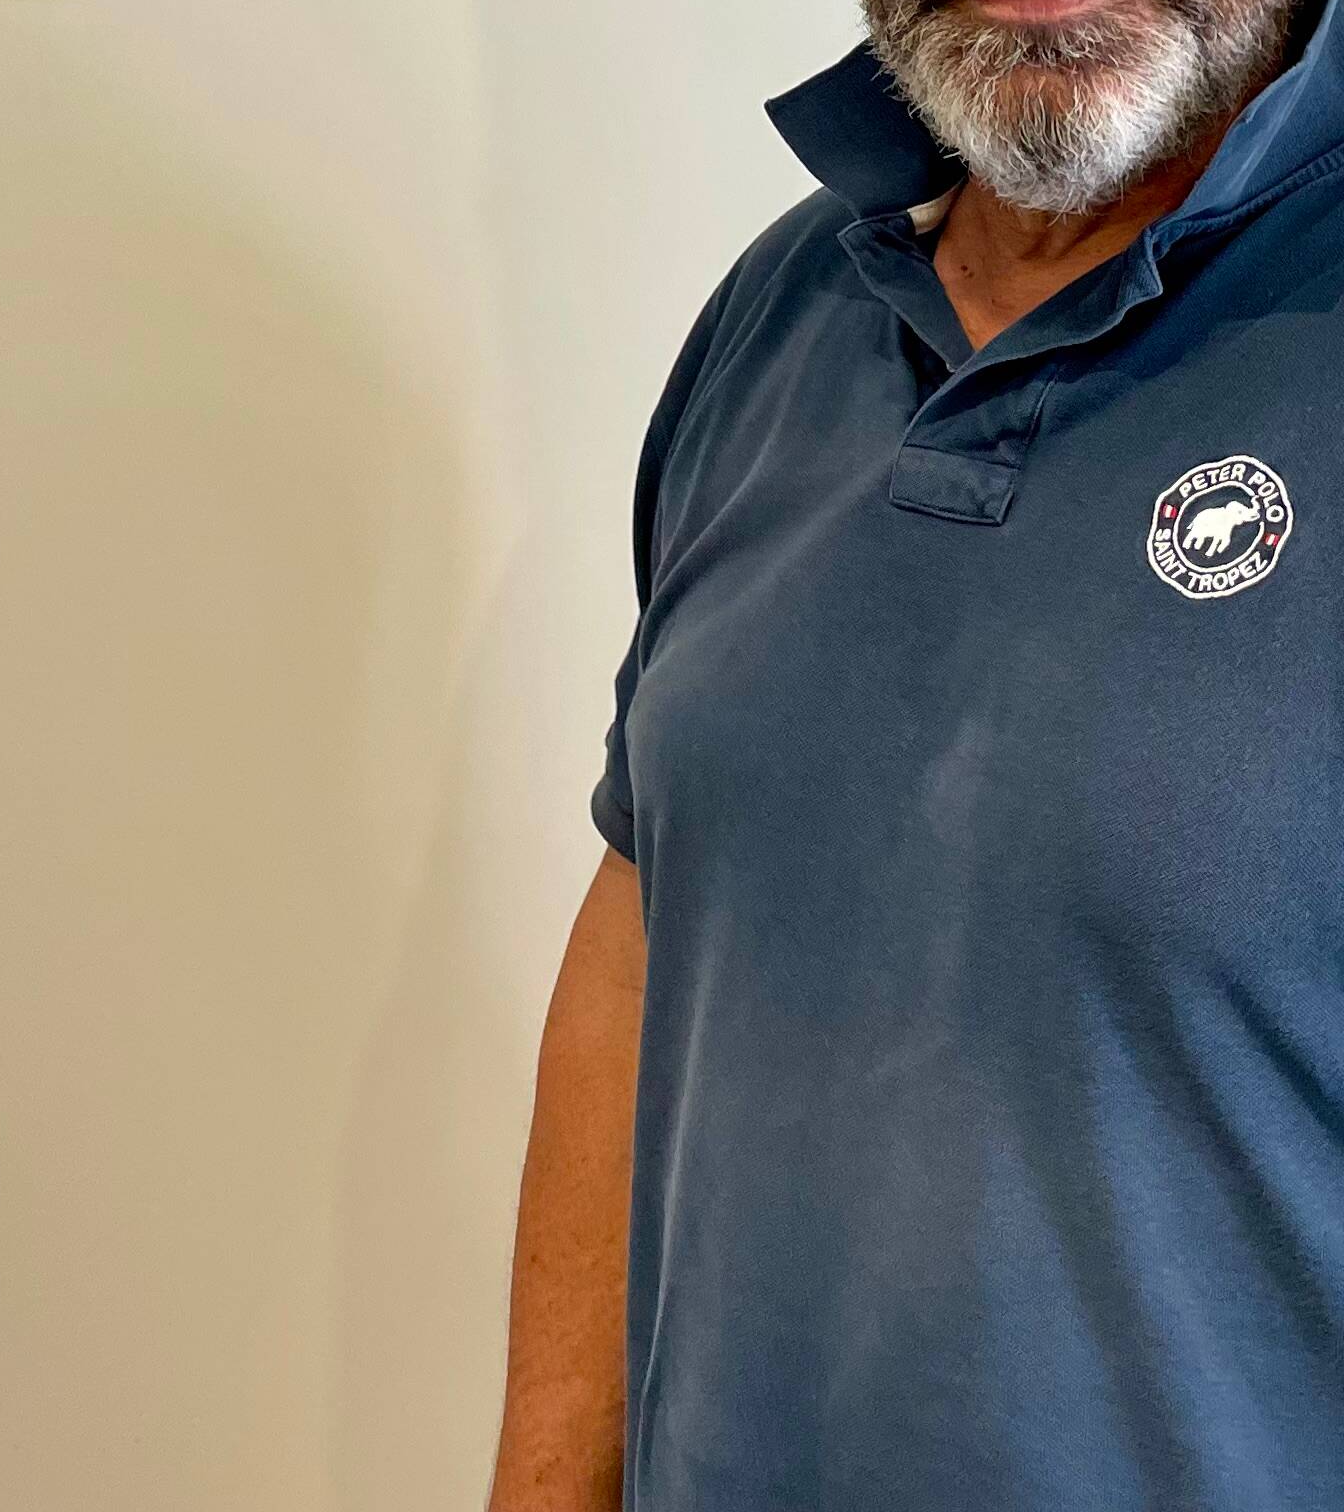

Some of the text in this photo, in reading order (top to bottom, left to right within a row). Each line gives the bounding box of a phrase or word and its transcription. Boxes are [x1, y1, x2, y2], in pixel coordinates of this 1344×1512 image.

[1179, 463, 1284, 522] PETER POLO
[1154, 529, 1267, 591] SAINT TROPEZ
